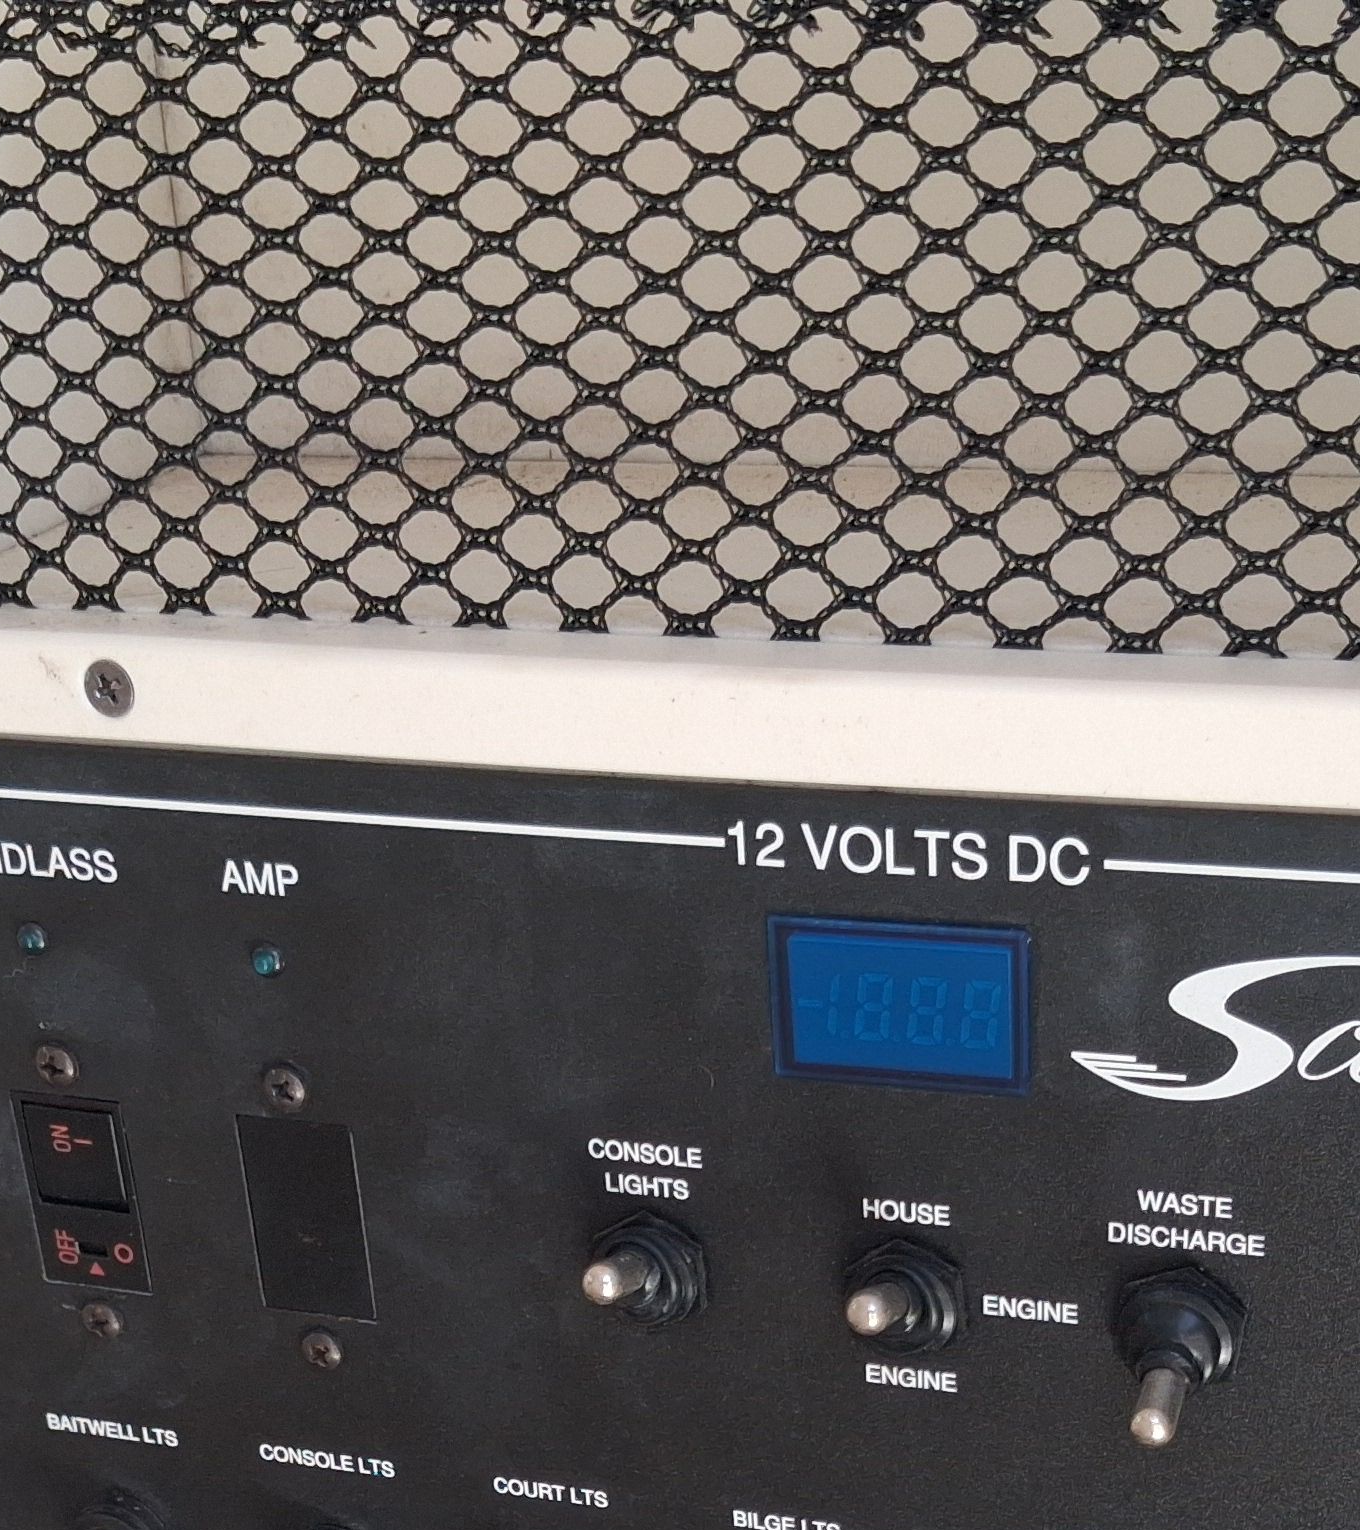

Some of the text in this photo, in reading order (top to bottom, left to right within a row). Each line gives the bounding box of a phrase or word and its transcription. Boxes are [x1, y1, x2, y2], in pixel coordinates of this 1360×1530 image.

[727, 820, 1090, 886] 12 VOLTS DC
[222, 859, 299, 897] AMP
[49, 1123, 73, 1154] ON
[587, 1137, 703, 1169] CONSOLE
[604, 1172, 690, 1201] LIGHTS
[862, 1198, 951, 1227] HOUSE
[1136, 1189, 1233, 1219] WASTE
[55, 1228, 79, 1265] OFF
[1108, 1221, 1265, 1257] DISCHARGE
[982, 1294, 1079, 1325] ENGINE
[865, 1363, 958, 1393] ENGINE
[45, 1412, 179, 1447] BAITWELL LTS
[259, 1443, 396, 1478] CONSOLE LTS
[493, 1476, 609, 1508] COURT LTS
